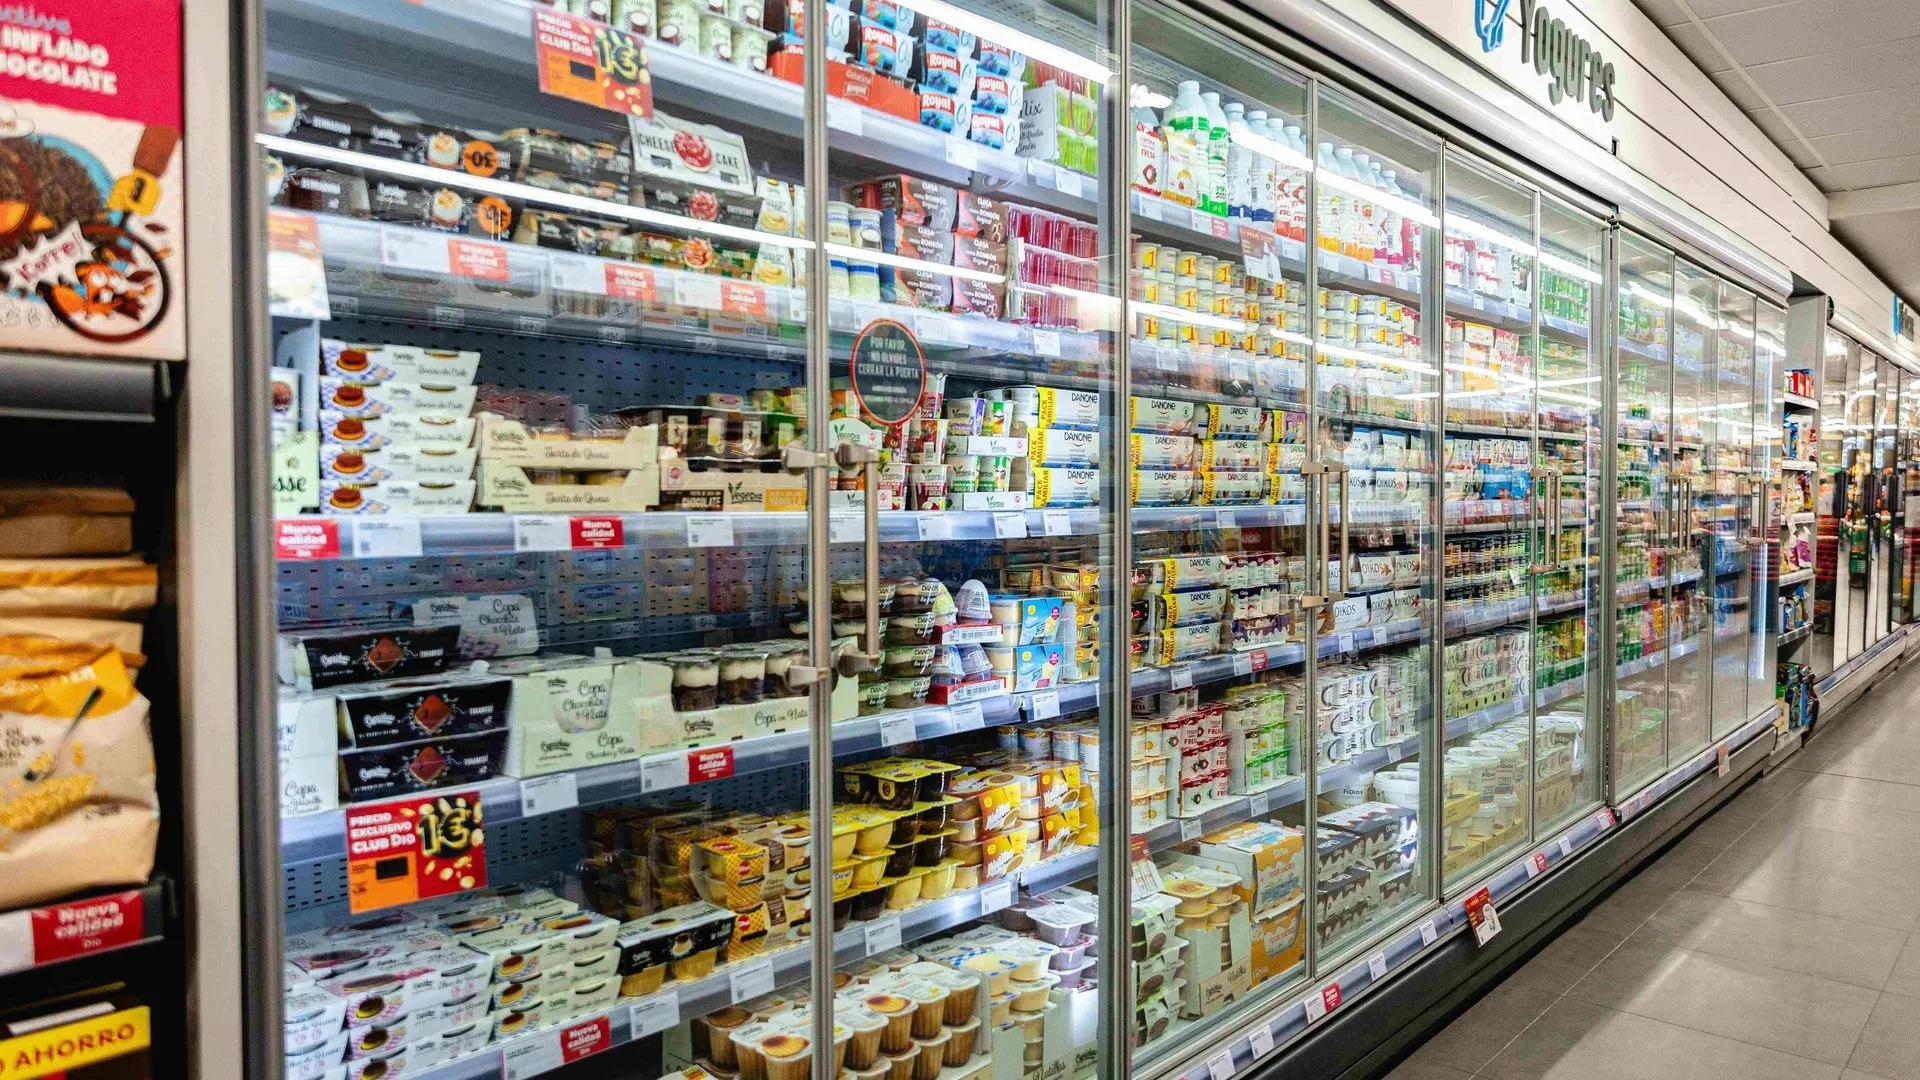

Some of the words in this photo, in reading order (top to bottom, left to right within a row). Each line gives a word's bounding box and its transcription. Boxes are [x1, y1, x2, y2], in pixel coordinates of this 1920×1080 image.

[865, 28, 893, 46] Royal
[2, 25, 109, 67] INFLADO
[929, 54, 957, 70] Royal
[1520, 0, 1616, 123] Yogures
[0, 51, 117, 94] OCOLATE
[979, 77, 1005, 93] Royal
[922, 94, 951, 110] Royal
[972, 114, 1000, 130] Royal
[716, 152, 739, 169] CAKE
[1072, 393, 1098, 404] DANONE
[1151, 401, 1176, 411] DANONE
[1230, 407, 1248, 415] DANONE
[1064, 432, 1092, 443] DANONE
[1154, 436, 1178, 446] DANONE
[1227, 440, 1247, 449] DANONE
[1068, 470, 1094, 480] DANONE
[1154, 471, 1177, 481] DANONE
[1228, 473, 1248, 481] DANONE
[582, 520, 612, 529] Nueva
[581, 528, 615, 538] calidad
[1190, 558, 1211, 568] DANONE
[1190, 593, 1211, 602] DANONE
[1335, 605, 1355, 618] OIKOS
[1189, 626, 1210, 636] DANONE
[578, 680, 606, 697] Copa
[754, 710, 778, 728] Copa
[598, 731, 625, 747] Copa
[699, 751, 724, 762] Nueva
[698, 758, 727, 772] calidad
[285, 780, 318, 800] Copa
[351, 812, 392, 826] PRECIO
[351, 821, 412, 838] EXCLUSIVO
[351, 839, 389, 854] CLUB
[59, 902, 120, 922] Nueva
[54, 913, 124, 939] calidad
[569, 1023, 599, 1039] Nueva
[15, 1023, 135, 1071] AHORRO
[567, 1032, 601, 1049] calidad
